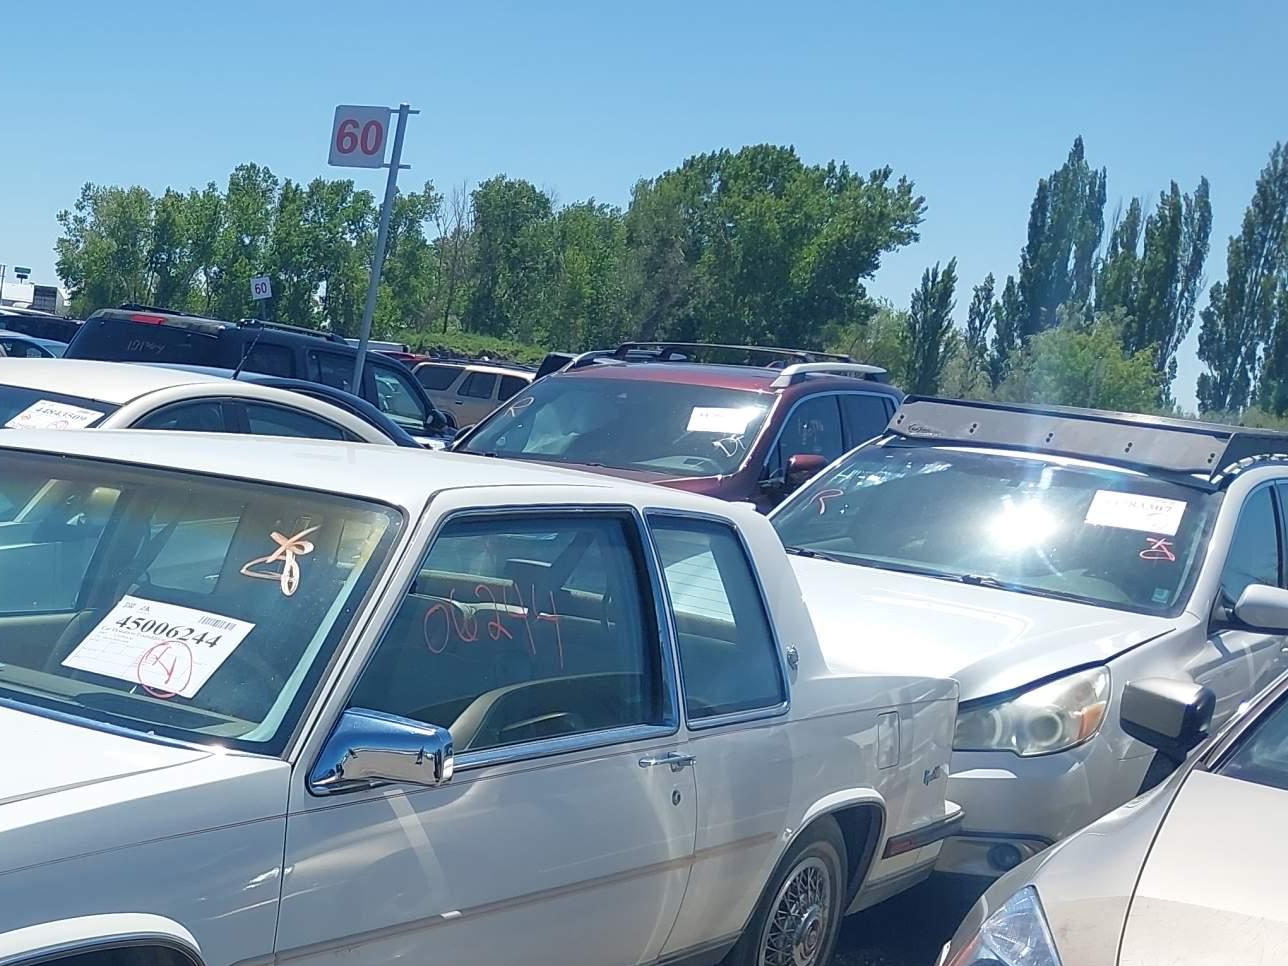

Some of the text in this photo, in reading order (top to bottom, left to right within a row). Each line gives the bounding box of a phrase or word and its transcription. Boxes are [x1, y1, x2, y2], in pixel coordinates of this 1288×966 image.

[336, 119, 383, 155] 60
[254, 283, 267, 294] 60
[115, 615, 223, 649] 45006244
[423, 583, 564, 670] 06244
